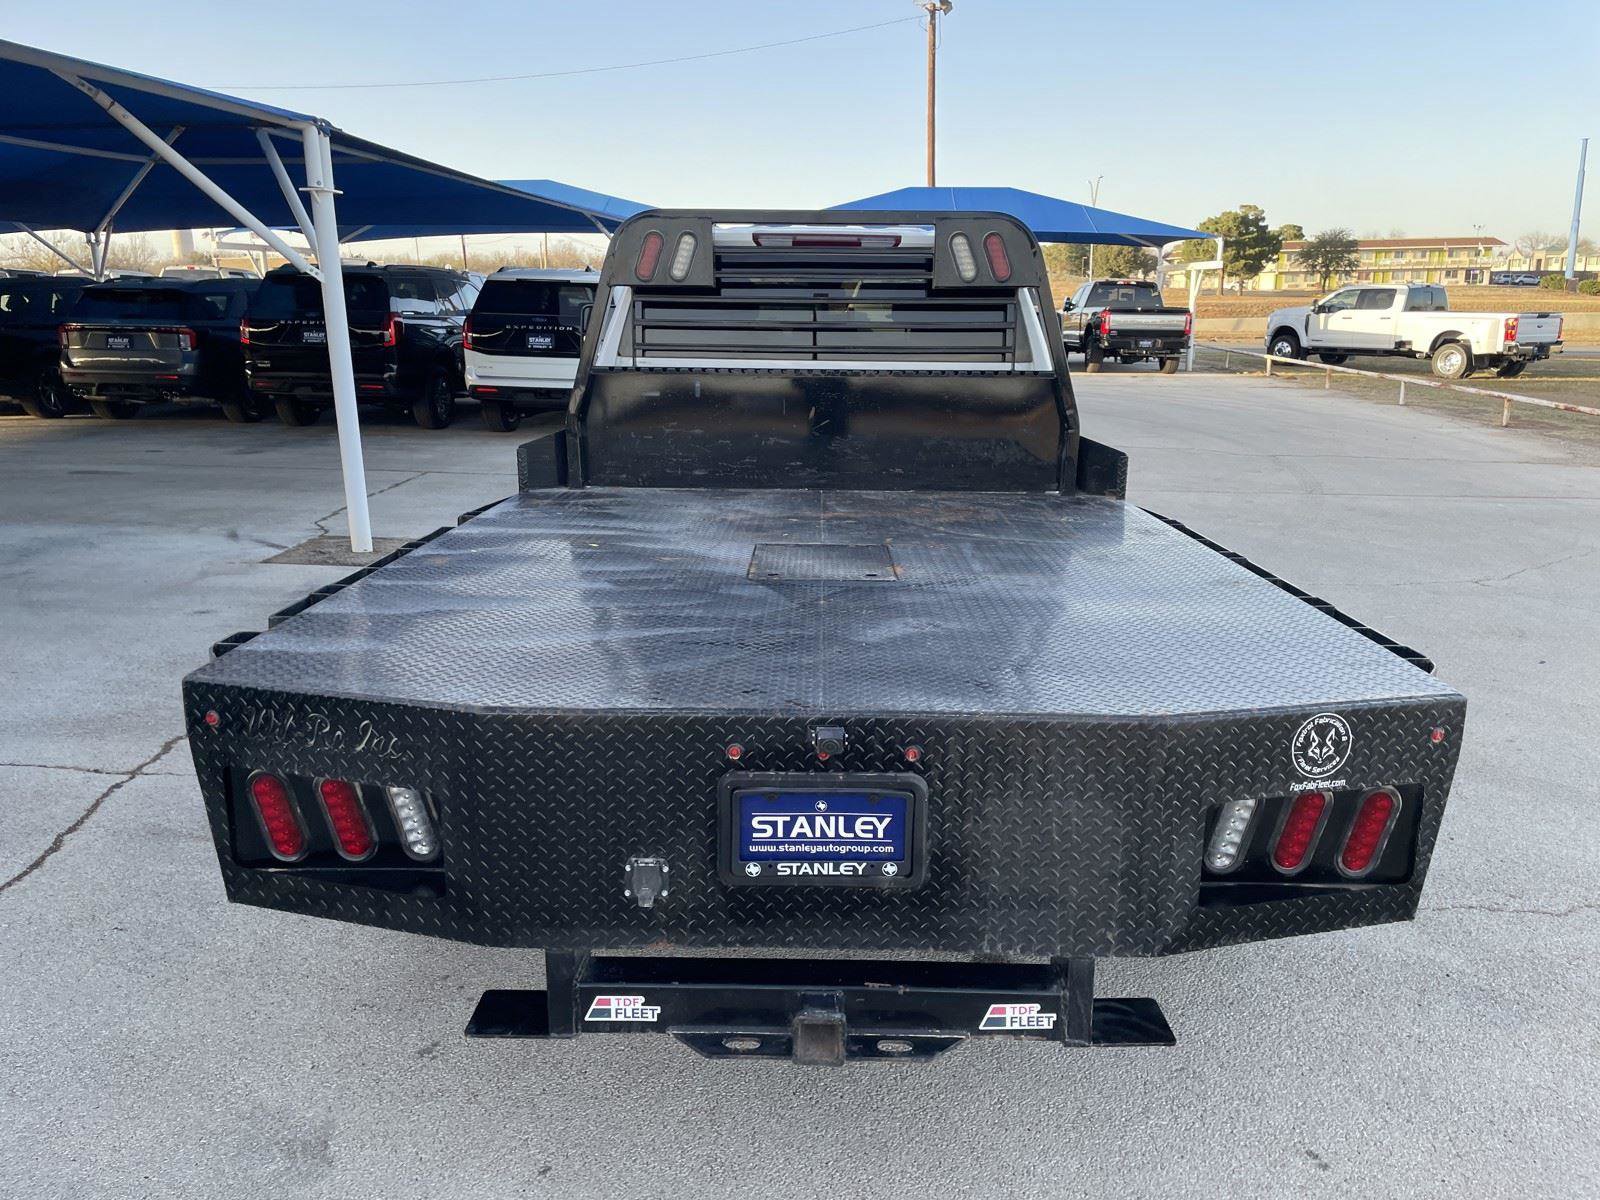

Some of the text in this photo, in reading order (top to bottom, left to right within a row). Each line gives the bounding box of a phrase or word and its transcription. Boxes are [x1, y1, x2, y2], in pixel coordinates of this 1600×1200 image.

[1312, 756, 1340, 773] Services
[1289, 779, 1346, 792] FoxFabFleet.com
[751, 815, 892, 839] STANLEY
[749, 843, 894, 854] www.stanleyautogroup.com
[776, 862, 867, 876] STANLEY
[614, 998, 640, 1006] TDF
[615, 1008, 658, 1019] FLEET
[1010, 1006, 1035, 1014] TDF
[1010, 1016, 1055, 1027] FLEET
